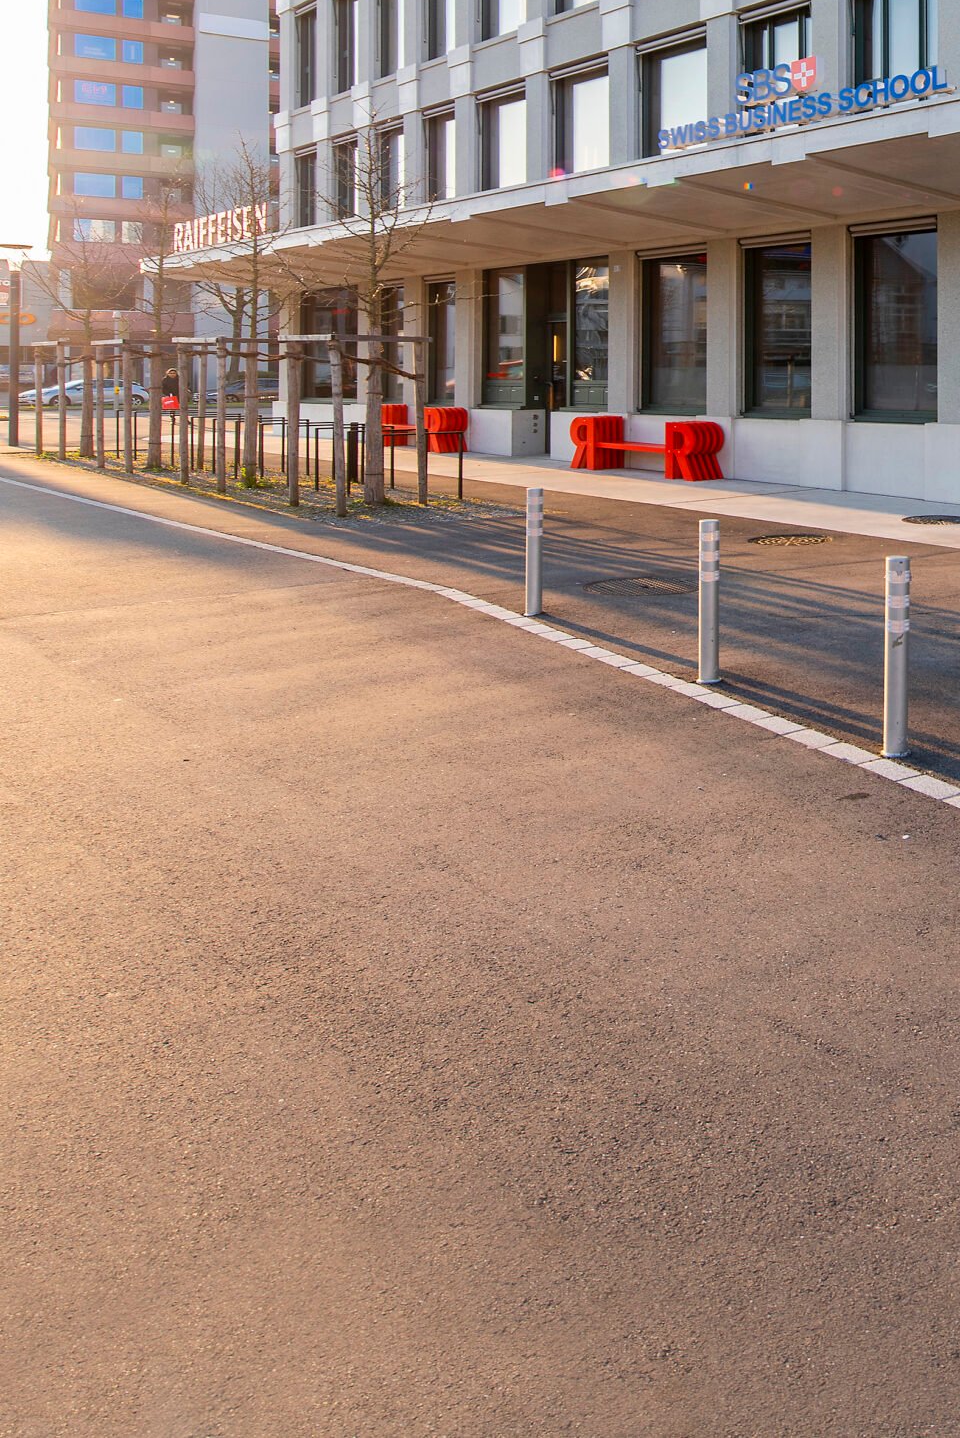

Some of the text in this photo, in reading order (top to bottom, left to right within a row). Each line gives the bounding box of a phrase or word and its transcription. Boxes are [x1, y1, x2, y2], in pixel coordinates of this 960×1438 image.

[657, 65, 948, 150] SWISS BUSINESS SCHOOL
[735, 63, 792, 106] SBS
[173, 202, 268, 252] RAIFFEISEN
